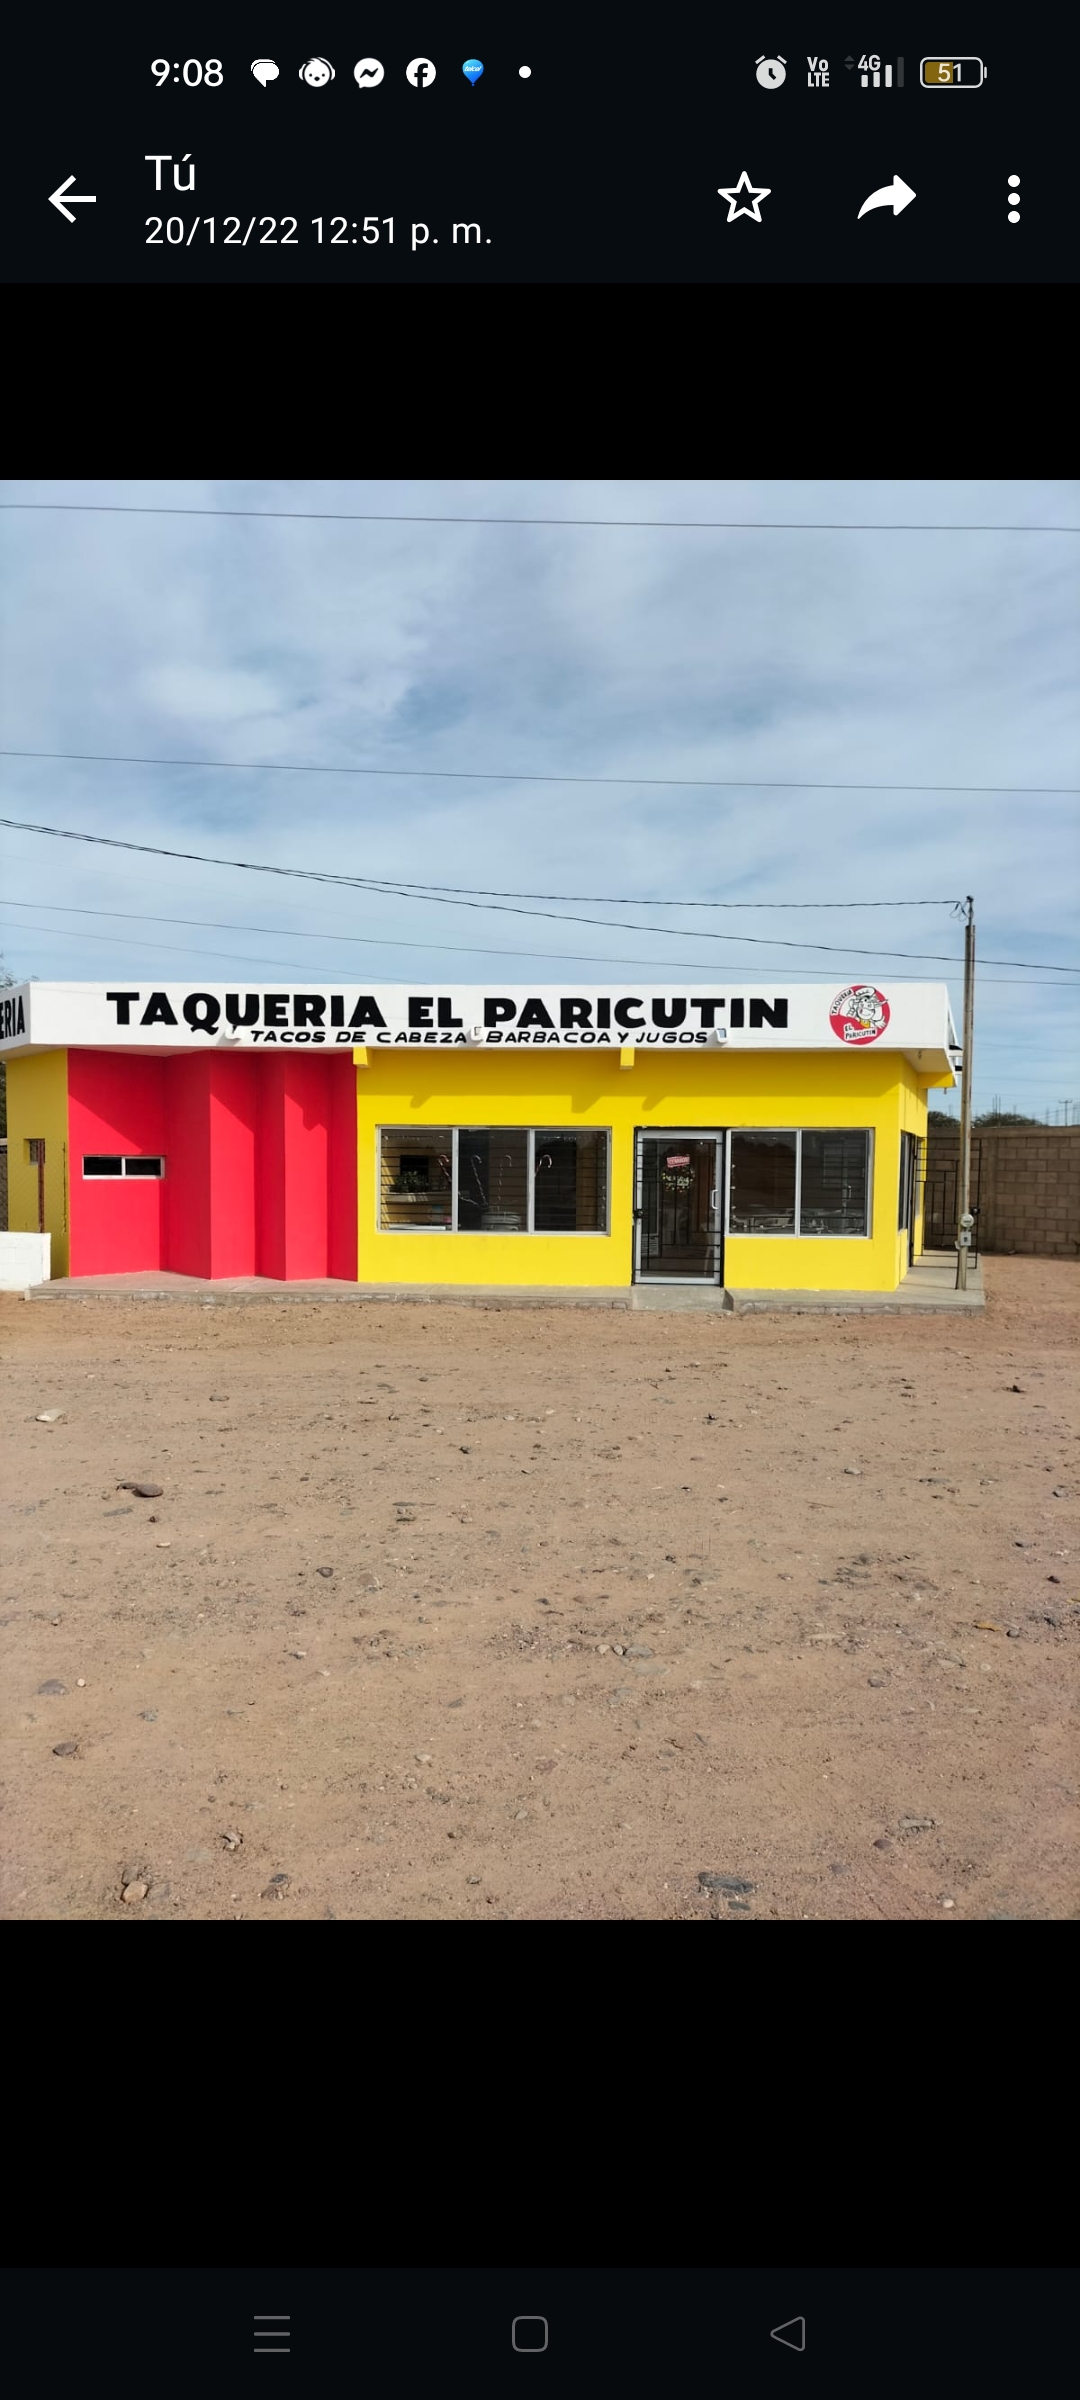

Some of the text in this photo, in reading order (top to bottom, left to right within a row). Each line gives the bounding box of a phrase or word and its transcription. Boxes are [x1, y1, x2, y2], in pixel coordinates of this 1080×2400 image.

[107, 992, 789, 1036] TAQUERIA EL PARICUTIN
[845, 1024, 853, 1032] EL
[250, 1030, 708, 1044] TACOS DE CABEZA BARBACOA Y JUGOS
